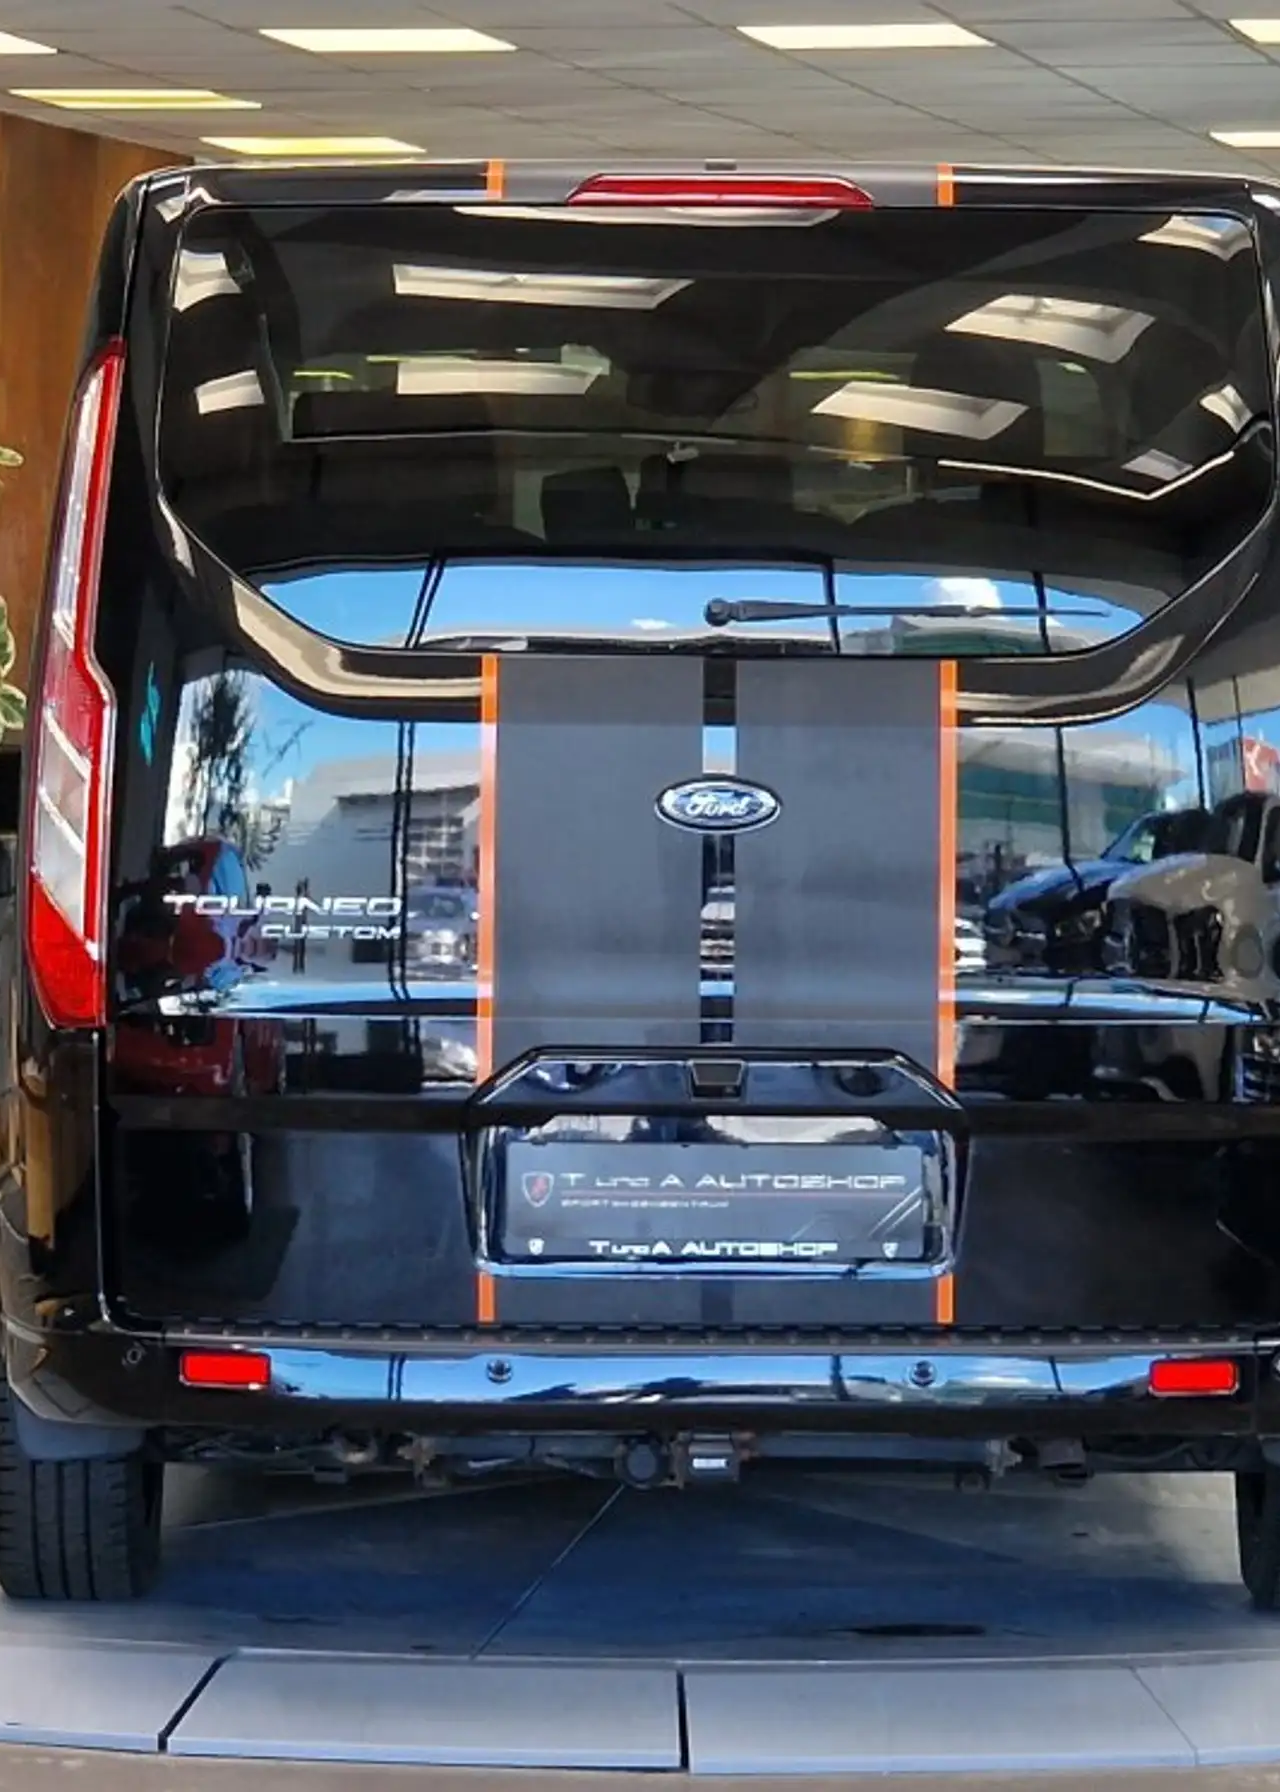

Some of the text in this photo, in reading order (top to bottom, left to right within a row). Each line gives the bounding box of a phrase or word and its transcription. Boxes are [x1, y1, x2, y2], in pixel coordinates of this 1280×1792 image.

[686, 790, 752, 817] Ford
[162, 894, 403, 916] TOURNEO
[260, 924, 402, 940] CUSTOM
[559, 1172, 586, 1187] T
[659, 1173, 685, 1188] A
[694, 1173, 907, 1189] AUTOSHOP
[681, 1240, 838, 1256] AUTOSHOP
